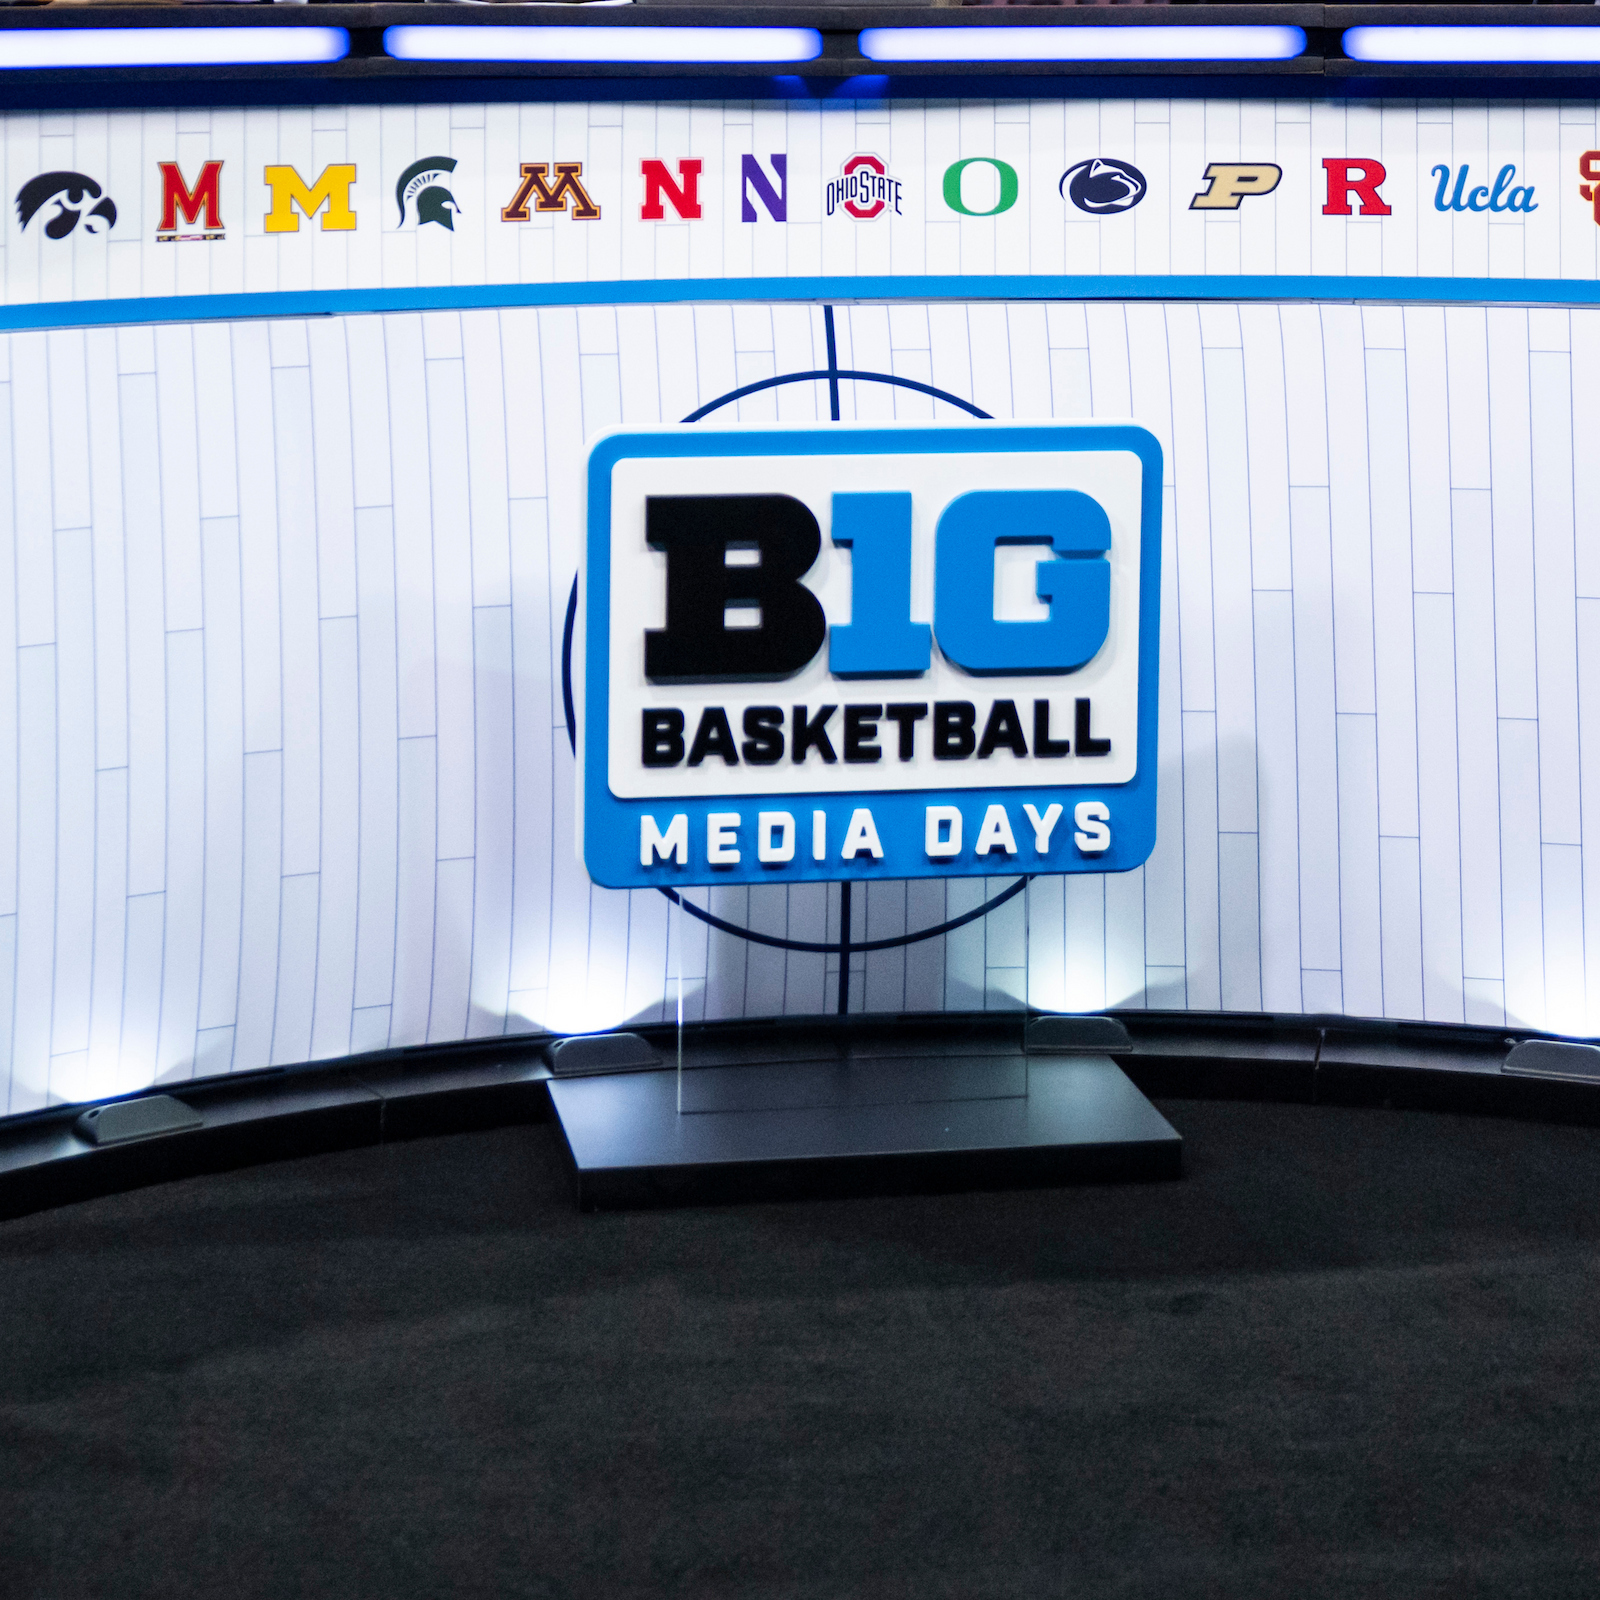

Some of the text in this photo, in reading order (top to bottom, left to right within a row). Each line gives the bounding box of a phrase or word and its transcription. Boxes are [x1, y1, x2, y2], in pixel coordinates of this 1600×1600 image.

[157, 160, 224, 232] M
[264, 163, 357, 233] M
[501, 161, 601, 223] M
[638, 156, 704, 222] N
[741, 153, 788, 222] N
[942, 156, 1019, 216] O
[1189, 162, 1283, 211] P
[1322, 157, 1392, 215] R
[644, 489, 1112, 684] B1G
[641, 698, 1111, 767] BASKETBALL
[640, 801, 1112, 866] MEDIA DAYS
